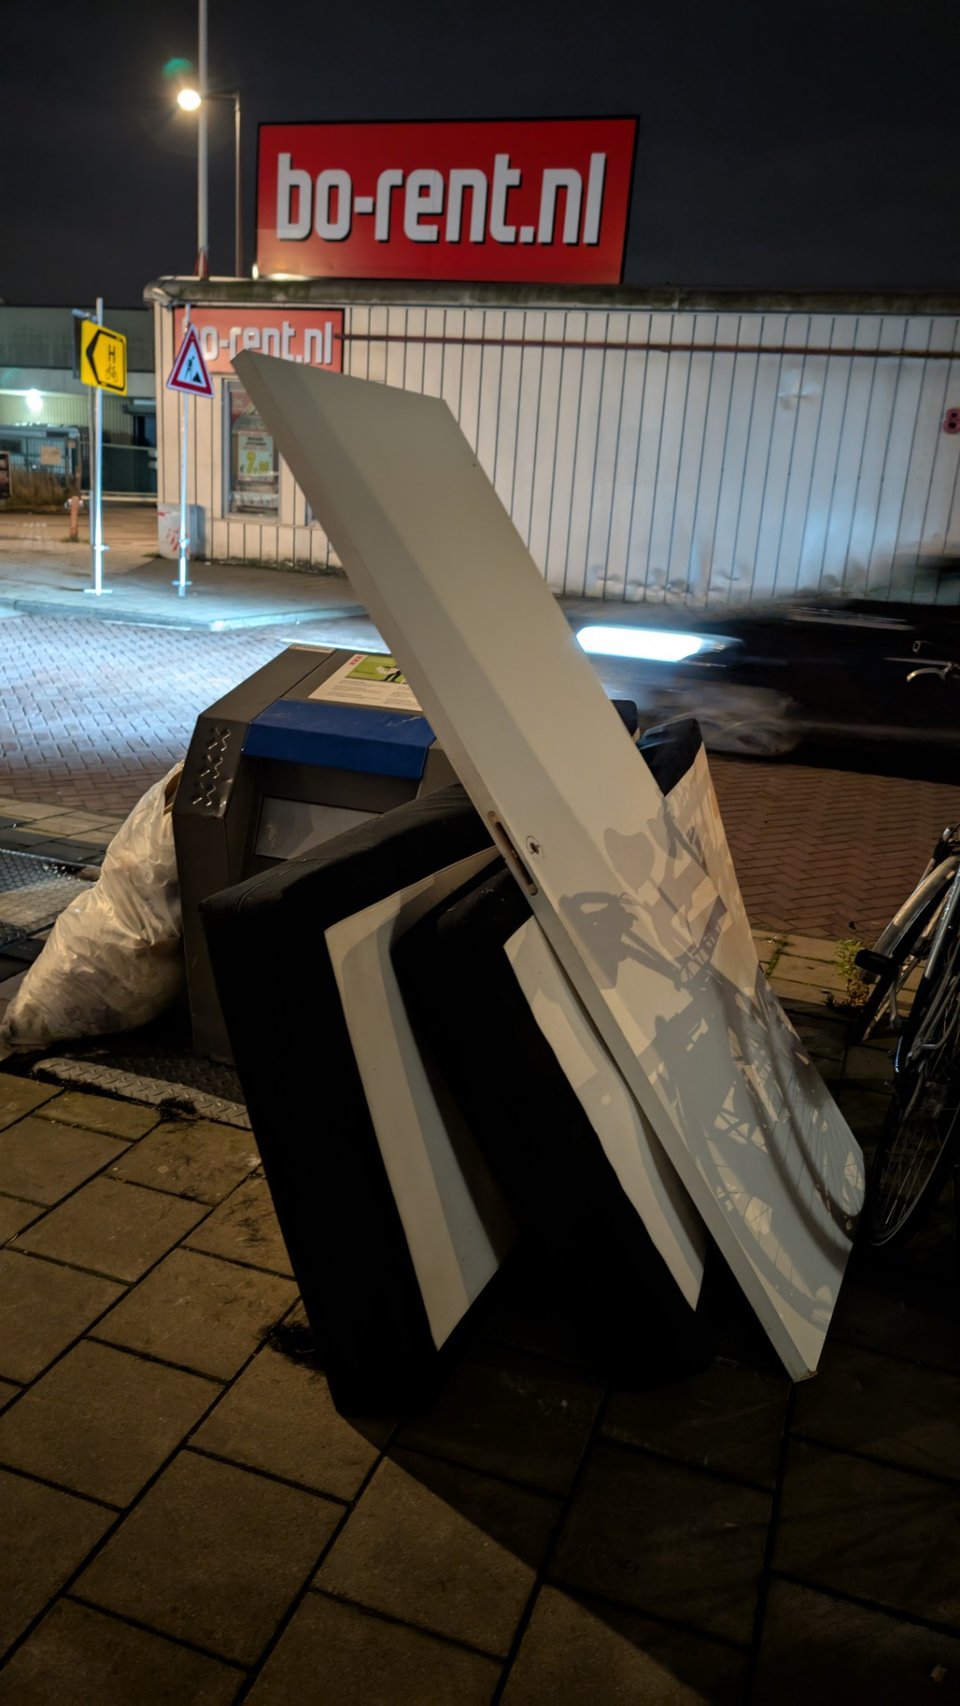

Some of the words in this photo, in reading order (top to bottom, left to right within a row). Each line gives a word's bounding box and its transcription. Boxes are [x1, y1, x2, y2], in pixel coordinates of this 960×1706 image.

[276, 152, 606, 244] bo-rent.nl
[107, 344, 116, 363] H
[182, 317, 332, 364] o-rent.nl
